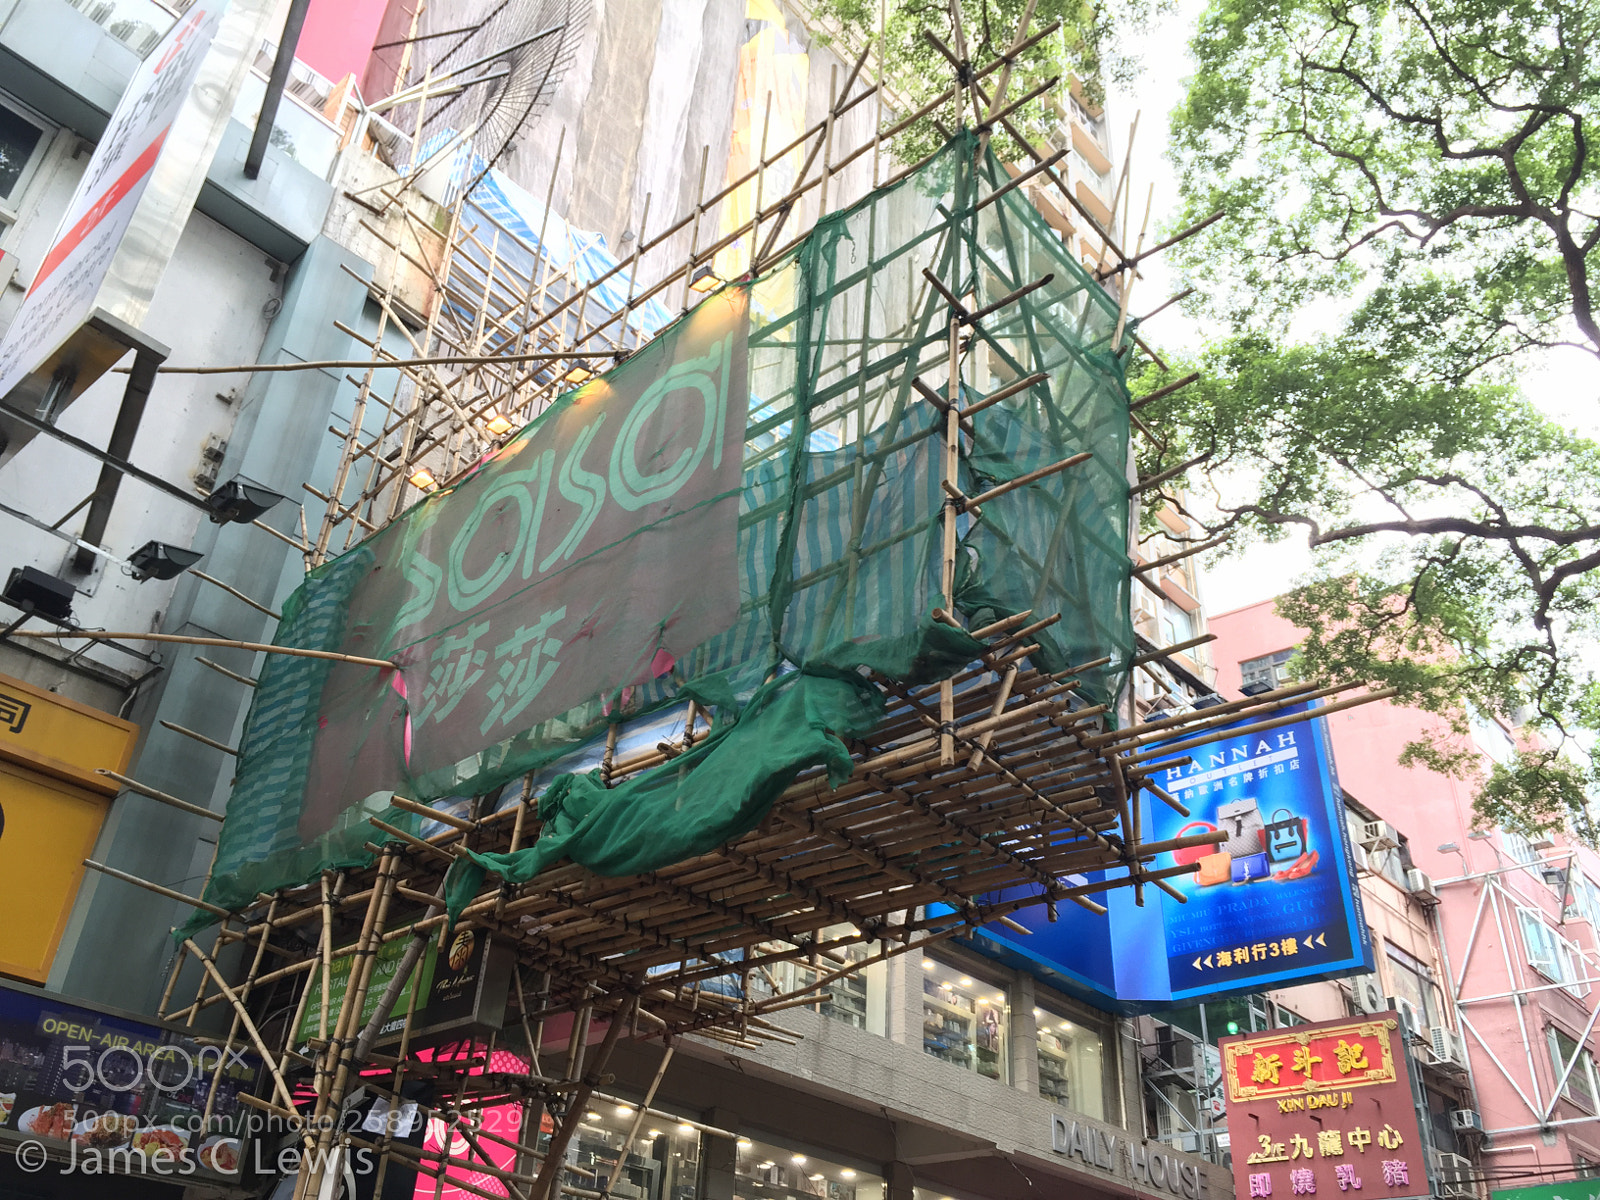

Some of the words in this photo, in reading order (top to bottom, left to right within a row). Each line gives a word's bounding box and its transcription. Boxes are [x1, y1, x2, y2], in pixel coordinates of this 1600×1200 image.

[413, 605, 567, 736] 莎莎
[1166, 731, 1296, 780] HANNAH
[1216, 937, 1299, 969] 海利行3樓
[43, 1018, 130, 1047] OPEN-AIR
[132, 1041, 175, 1063] AREA
[1251, 1039, 1369, 1085] 新斗記
[1277, 1098, 1305, 1114] XIN
[1306, 1093, 1339, 1110] DAU
[1341, 1091, 1354, 1109] JI
[1051, 1113, 1117, 1172] DAILY
[1129, 1142, 1208, 1200] HOUSE
[1289, 1123, 1404, 1160] 九龍中心
